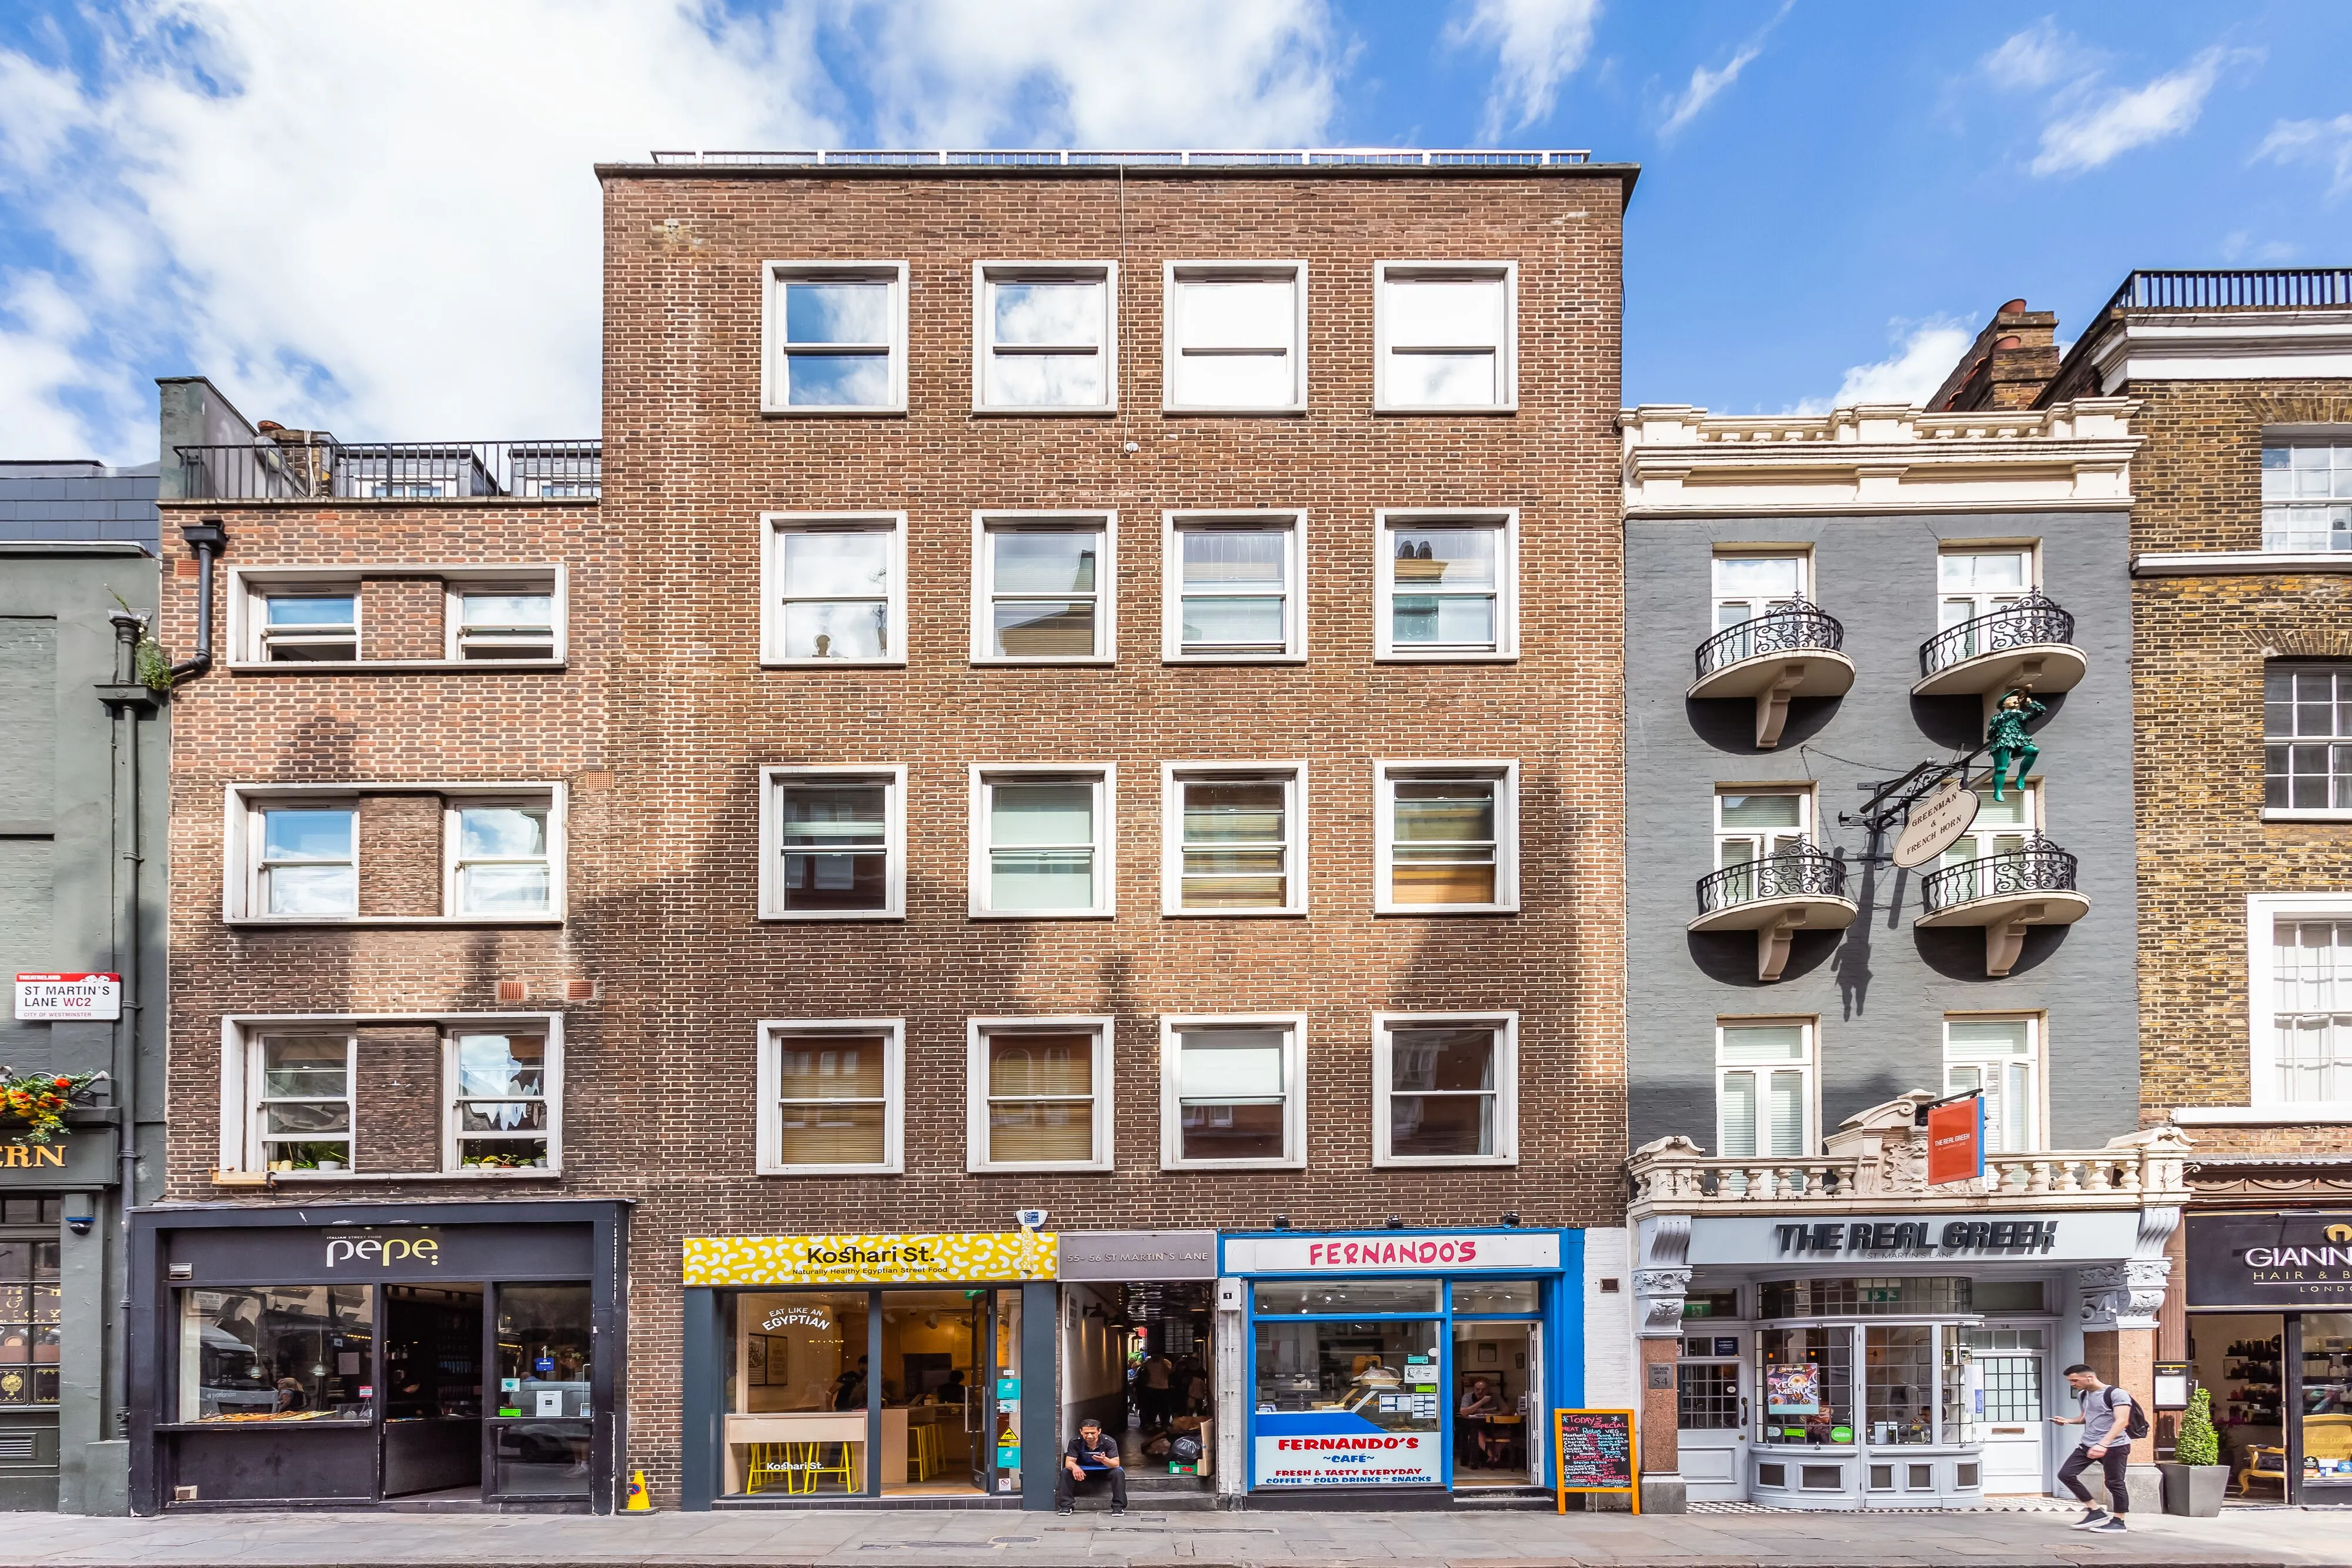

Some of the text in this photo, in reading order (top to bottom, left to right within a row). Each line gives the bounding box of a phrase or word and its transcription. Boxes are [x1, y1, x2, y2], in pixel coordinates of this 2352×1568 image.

[1912, 792, 1957, 827] GREENMAN
[1930, 819, 1937, 828] &
[1907, 814, 1962, 855] FRENCH HORN
[25, 986, 110, 995] ST MARTIN'S
[25, 998, 91, 1007] LANE WC2
[1955, 1133, 1970, 1141] GREEK
[0, 1145, 66, 1168] RN
[1776, 1220, 2059, 1251] THE REAL GREEK
[807, 1246, 935, 1263] Koshari St.
[1088, 1254, 1101, 1262] 56
[1104, 1253, 1117, 1262] ST
[1120, 1252, 1175, 1262] MARTIN'S
[1178, 1252, 1208, 1261] LANE
[1310, 1240, 1476, 1265] FERNANDO'S
[2253, 1271, 2304, 1280] HAIR
[2318, 1271, 2328, 1279] &
[2080, 1293, 2116, 1322] 54
[769, 1308, 785, 1318] EAT
[762, 1315, 830, 1331] EGYPTIAN
[1653, 1377, 1668, 1386] 54
[1566, 1415, 1602, 1425] TODAY'S
[1278, 1437, 1419, 1450] FERNANDO'S
[766, 1462, 807, 1470] Koshari
